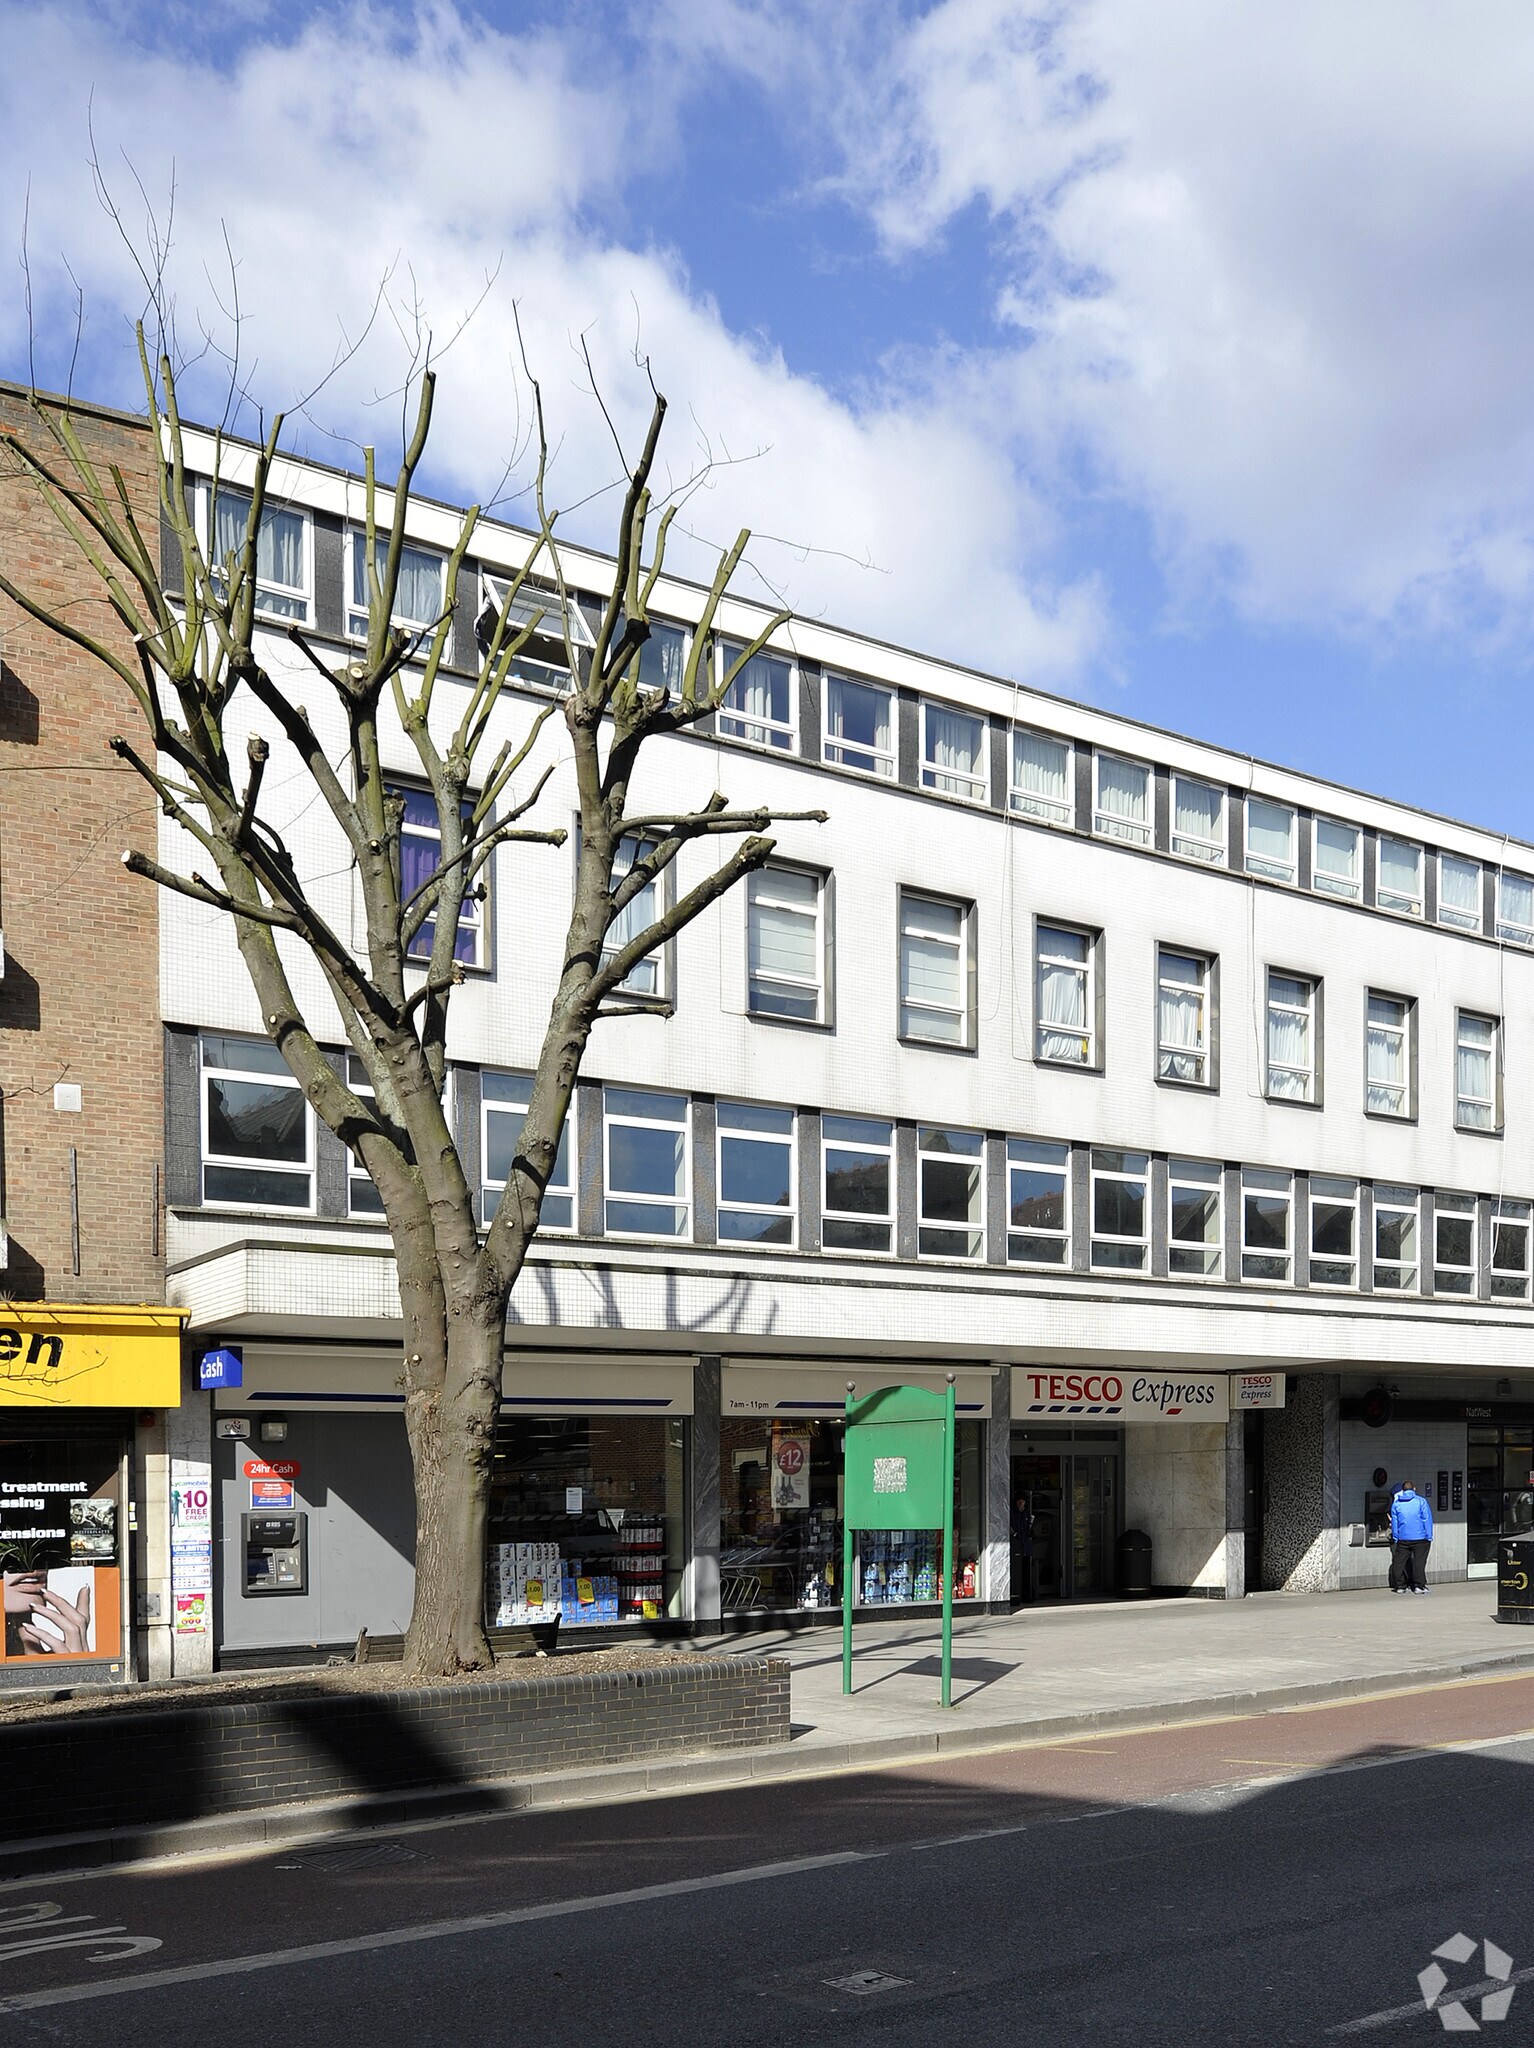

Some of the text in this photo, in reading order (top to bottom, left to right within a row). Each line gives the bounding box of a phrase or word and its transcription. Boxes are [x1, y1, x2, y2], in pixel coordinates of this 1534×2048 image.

[200, 1356, 223, 1379] Cash
[1241, 1375, 1272, 1385] TESCO
[1026, 1374, 1215, 1411] TESCO express
[1240, 1389, 1272, 1401] express
[730, 1400, 745, 1408] 7am
[750, 1400, 770, 1410] 11pm
[1465, 1407, 1491, 1417] NatWest
[779, 1449, 801, 1466] £12
[250, 1463, 294, 1474] 24hr Cash
[1, 1481, 88, 1493] treatment
[0, 1496, 45, 1511] ssing
[185, 1508, 208, 1516] FREE
[0, 1527, 66, 1540] ensions
